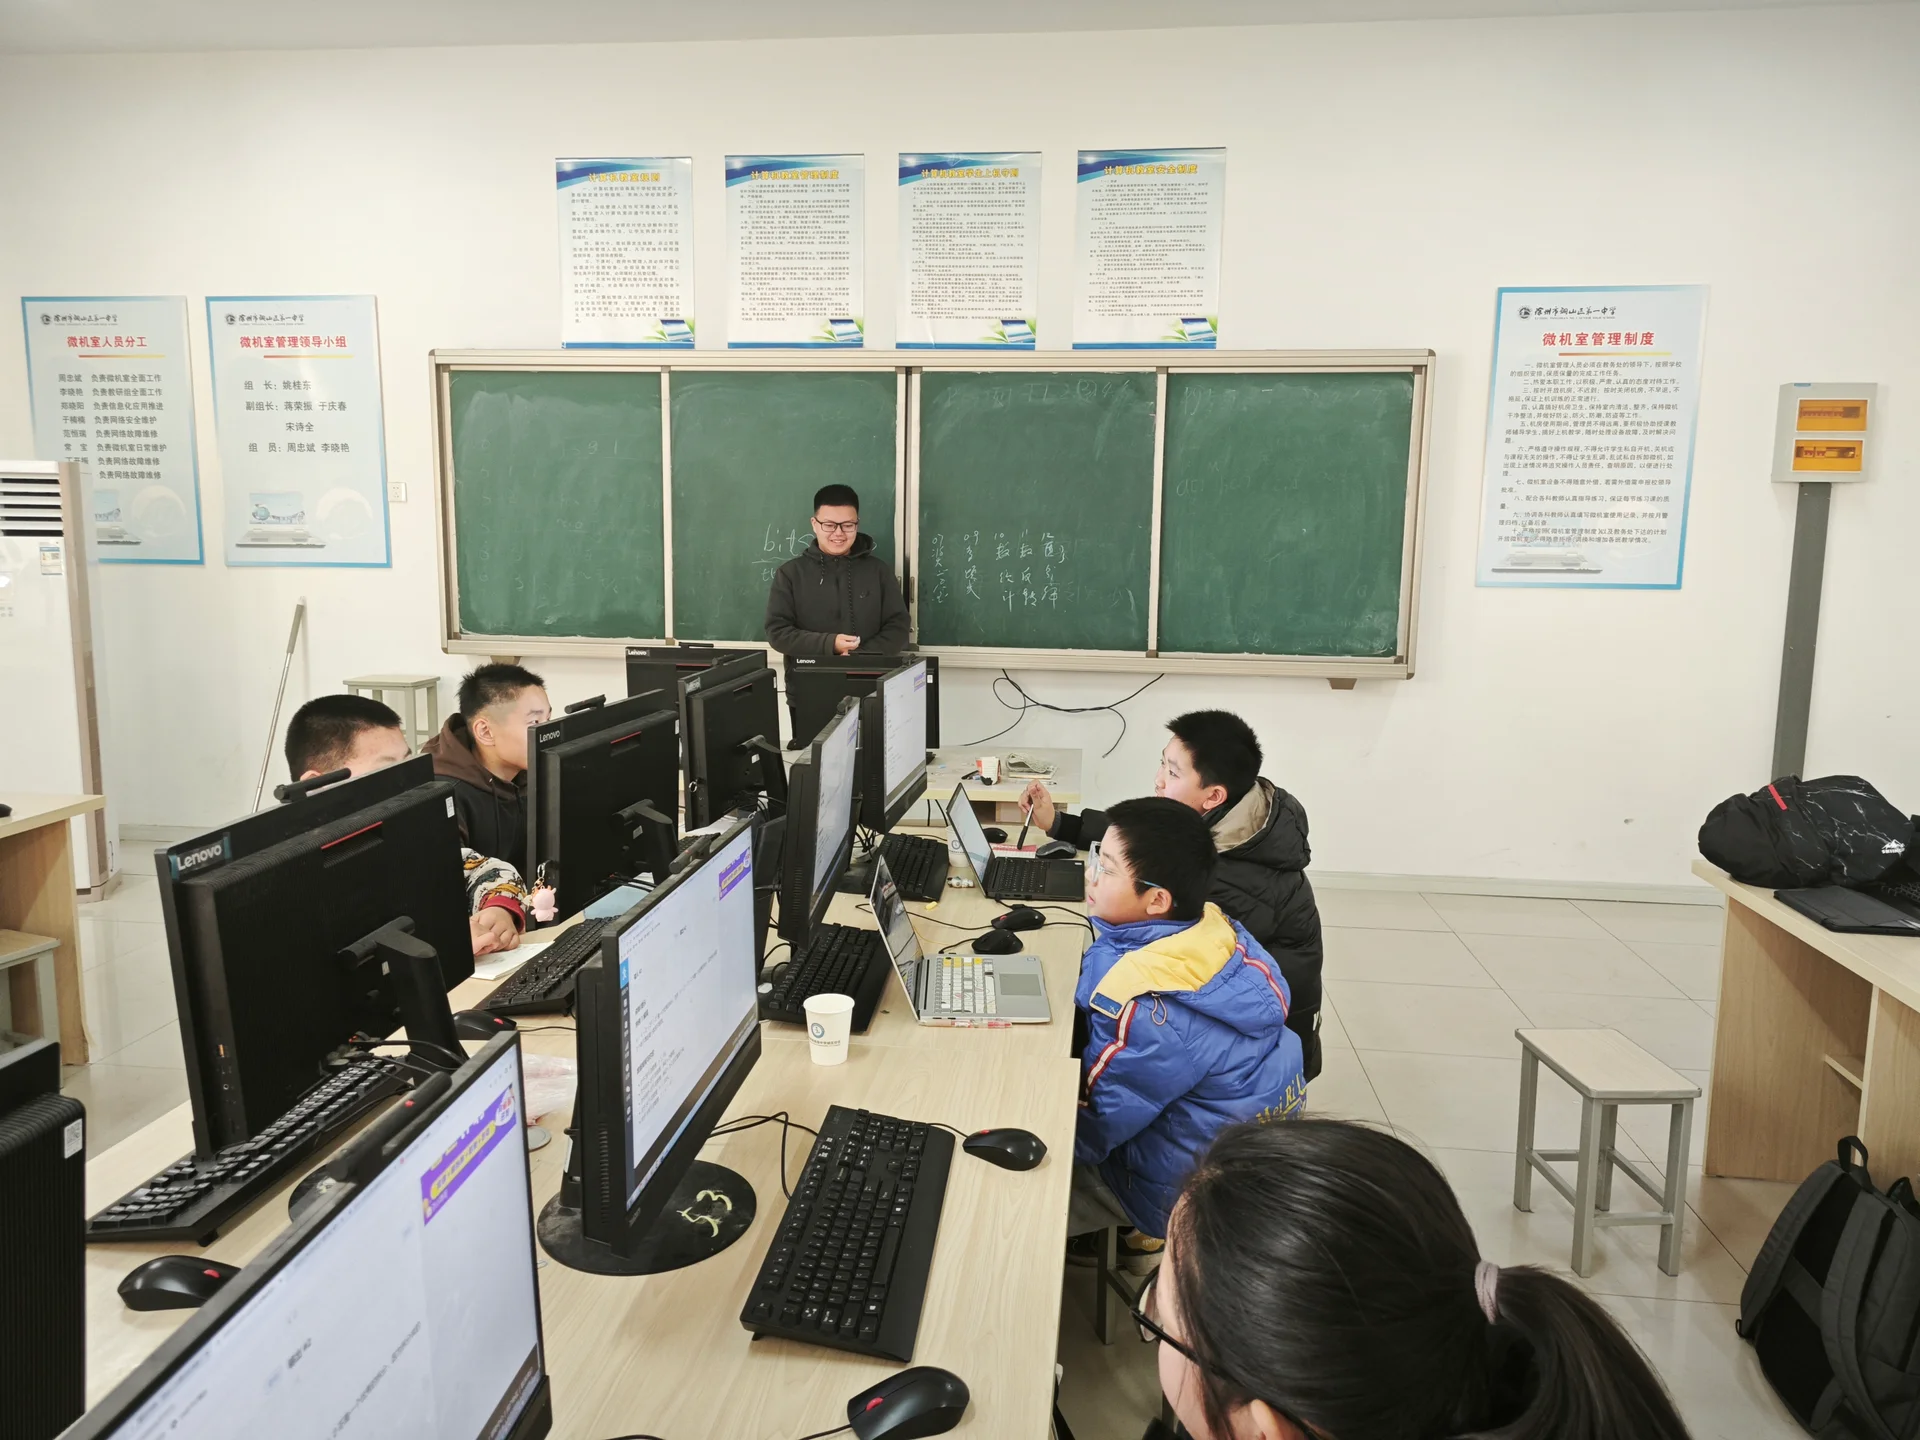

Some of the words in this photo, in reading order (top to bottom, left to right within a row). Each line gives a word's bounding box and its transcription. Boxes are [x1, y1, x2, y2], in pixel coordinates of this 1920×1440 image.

[921, 168, 1019, 178] 计算机教室学生上机守则
[1104, 164, 1198, 175] 计算机教室安全制度
[589, 173, 661, 182] 计算机教室规则
[751, 170, 839, 180] 计算机教室管理制度
[67, 336, 148, 348] 微机室人员分工
[240, 336, 347, 348] 微机室管理领导小组
[1543, 332, 1655, 346] 微机室管理制度
[91, 374, 162, 383] 负责微机室全面工作
[93, 402, 164, 410] 负责信息化应用推进
[94, 415, 157, 424] 负责网络安全维护
[286, 422, 314, 432] 宋诗全
[96, 429, 158, 438] 负责网络故障维修
[96, 443, 167, 452] 负责微机室日常维护
[98, 457, 160, 466] 负责网络故障维修
[99, 471, 162, 479] 负责网络故障维修
[627, 648, 648, 657] Lenovo
[539, 729, 562, 744] Lenovo
[176, 844, 223, 871] Lenovo
